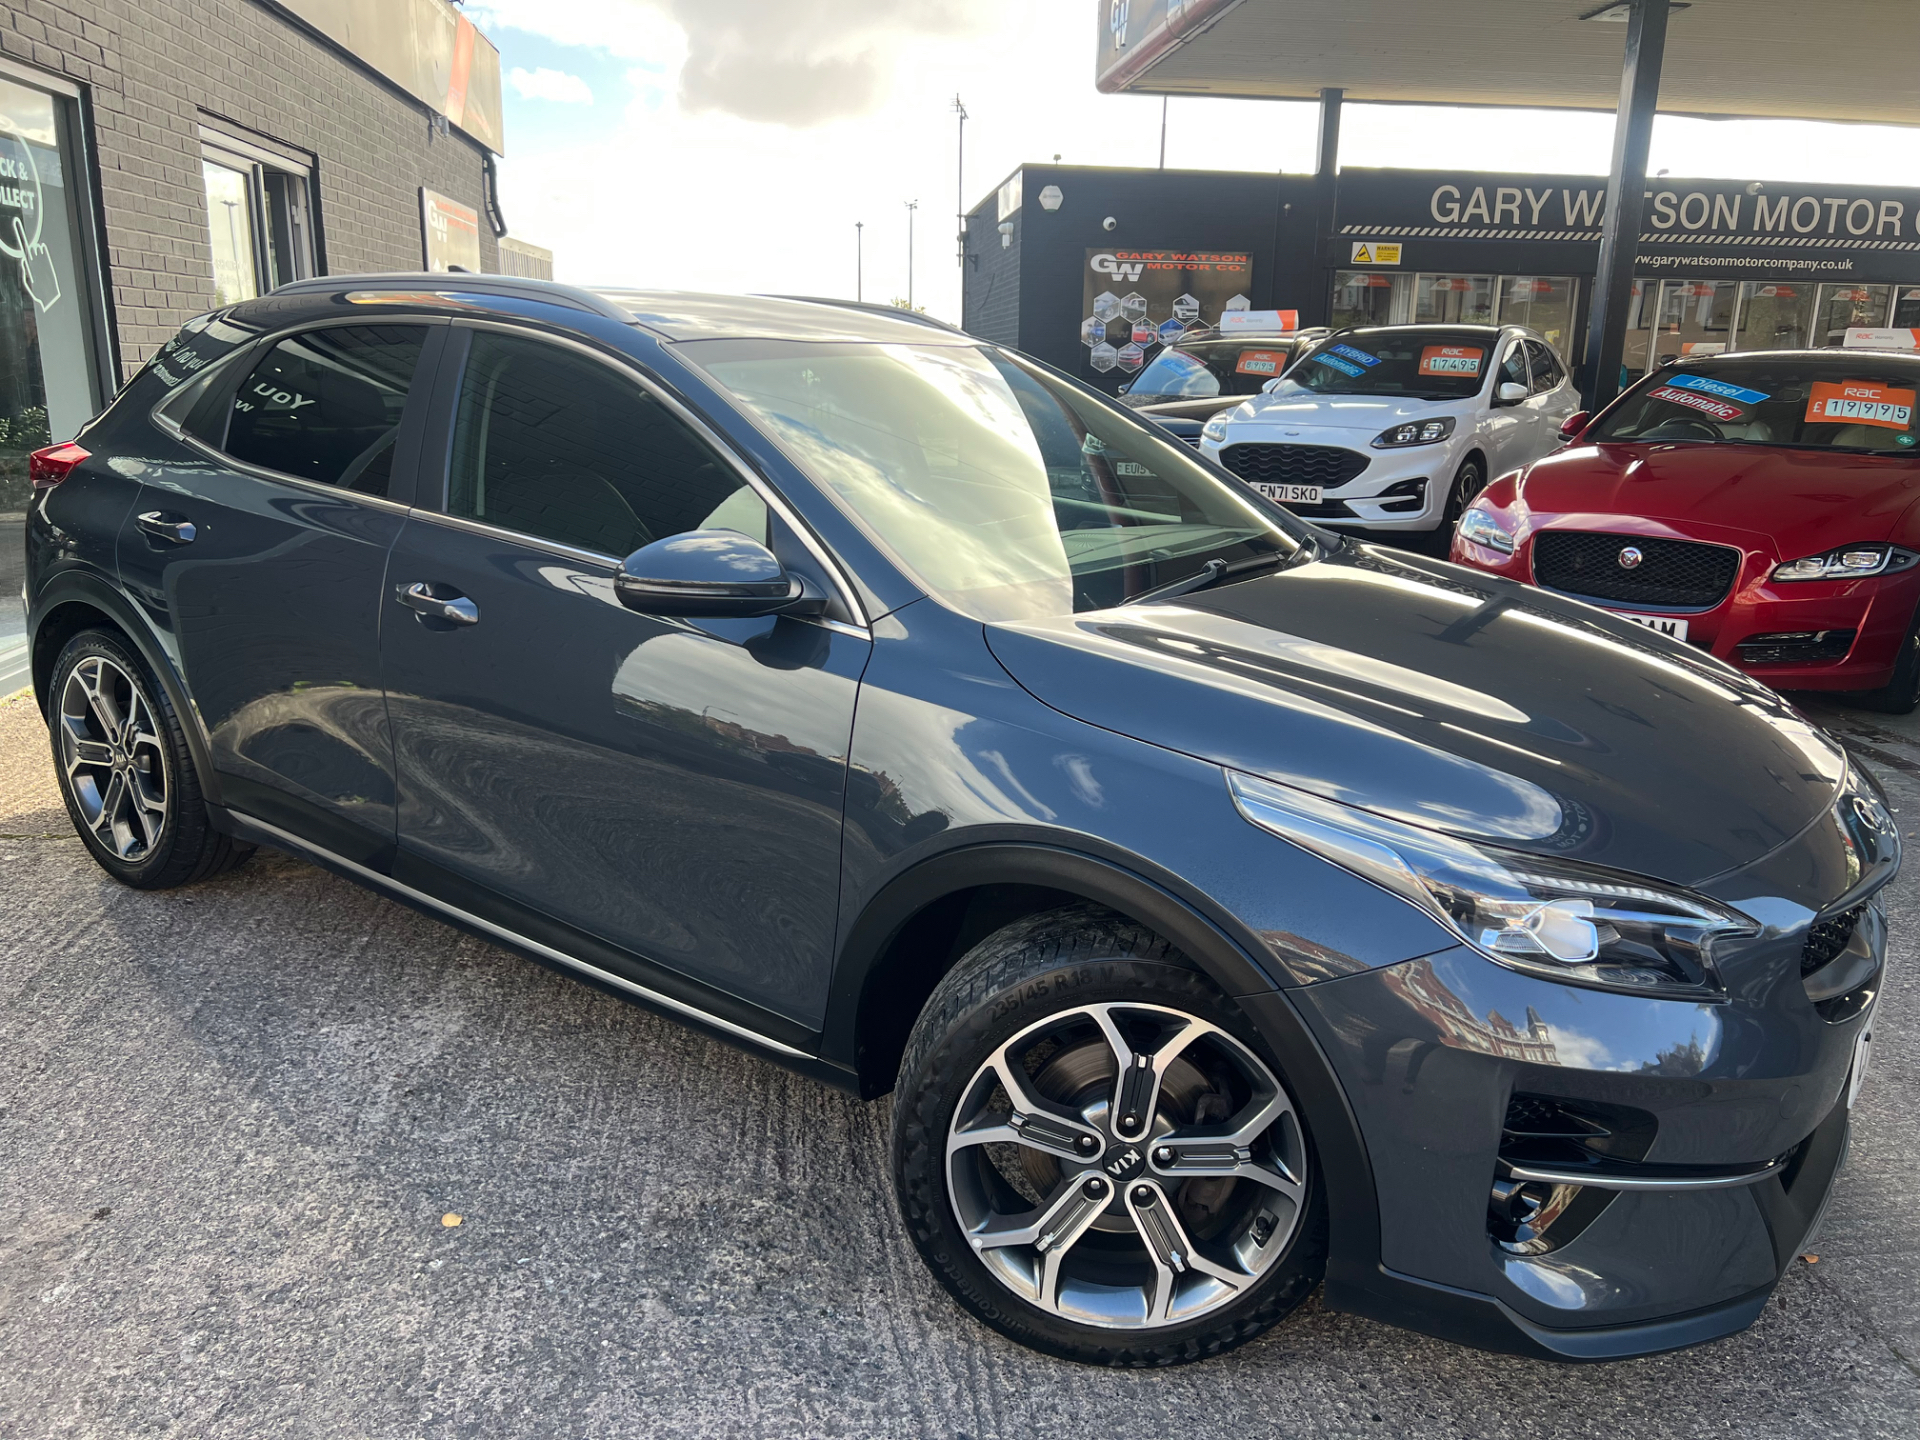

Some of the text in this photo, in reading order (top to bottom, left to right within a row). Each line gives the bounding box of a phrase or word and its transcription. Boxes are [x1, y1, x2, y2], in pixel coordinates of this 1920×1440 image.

[0, 156, 28, 181] CK &
[0, 185, 35, 210] LLECT
[1430, 184, 1553, 225] GARY
[1563, 189, 1741, 230] WSON
[1753, 195, 1905, 236] MOTOR
[427, 199, 448, 243] GW
[1090, 253, 1144, 282] GW
[1116, 252, 1247, 262] GARY WATSON
[1147, 262, 1245, 272] MOTOR CO.
[1635, 254, 1853, 271] w.garywatsonmotorcompany.co.uk
[1318, 354, 1359, 376] Automatic
[1336, 345, 1374, 364] HYBRID
[1687, 378, 1745, 396] Diesel
[1655, 388, 1733, 417] Automatic
[1107, 1149, 1141, 1175] KIA
